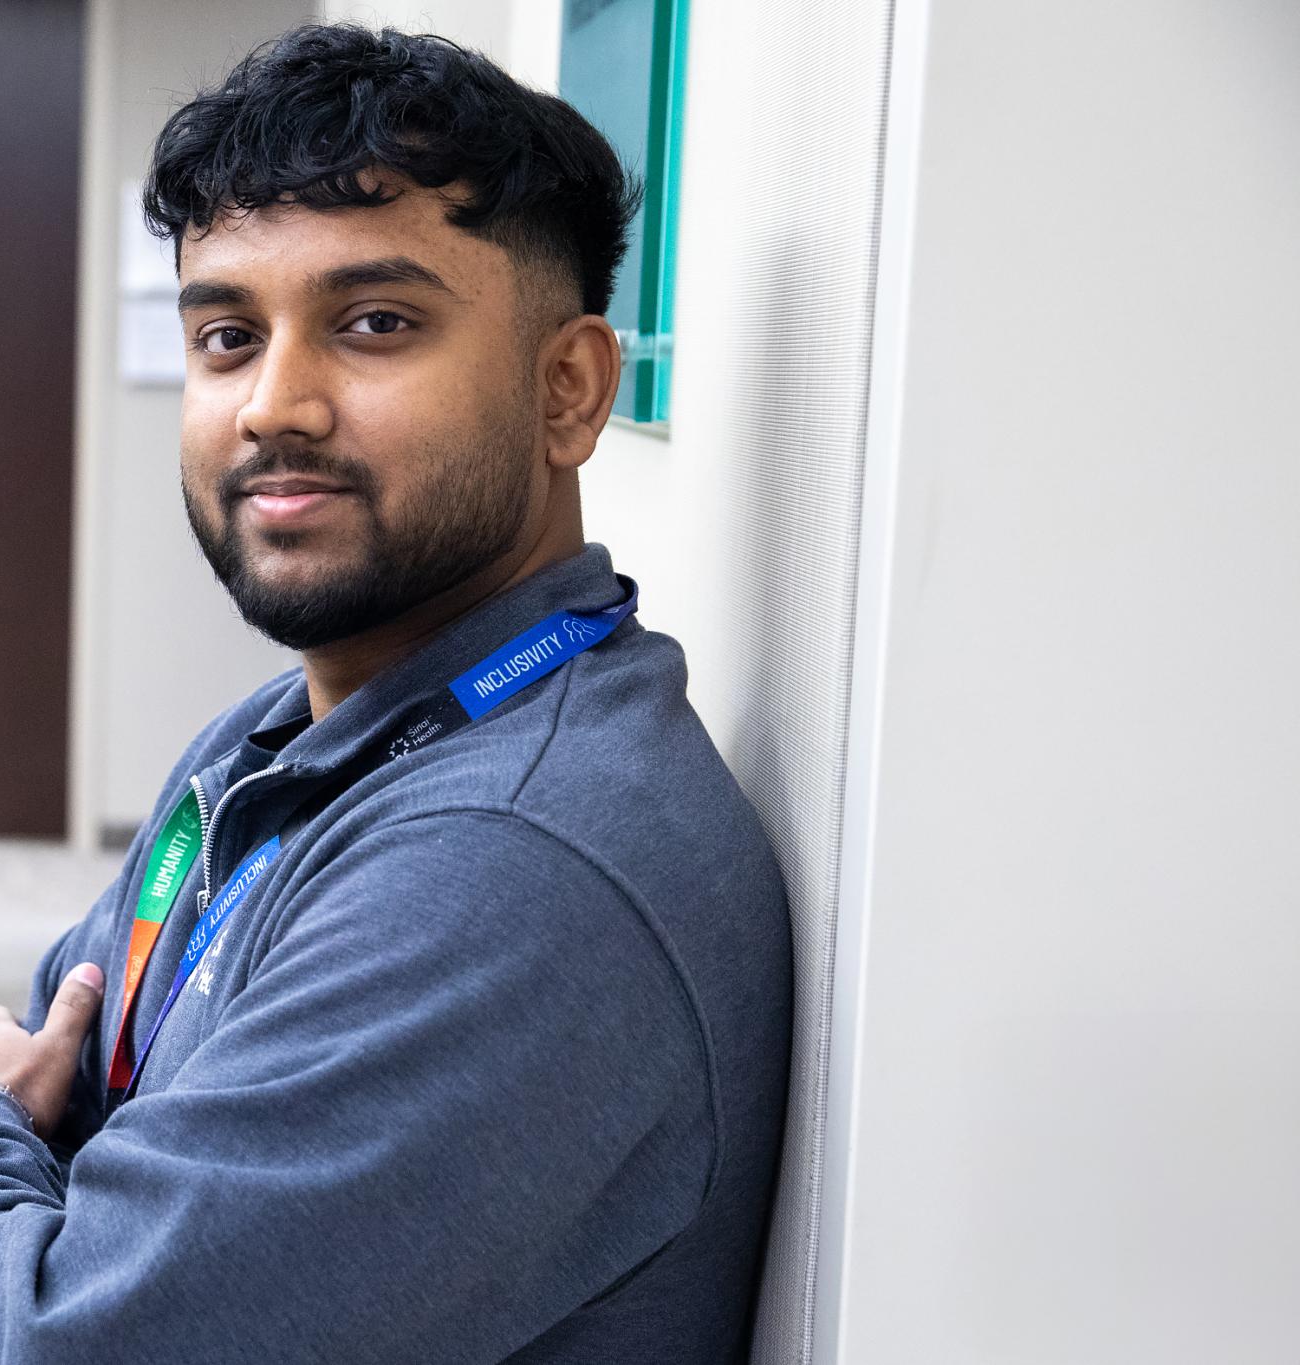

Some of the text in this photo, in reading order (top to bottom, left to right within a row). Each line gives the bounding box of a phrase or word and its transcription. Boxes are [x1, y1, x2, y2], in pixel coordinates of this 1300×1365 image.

[473, 632, 563, 698] INCLUSIVITY
[407, 716, 431, 738] Sinai
[412, 722, 443, 747] Health
[151, 829, 192, 898] HUMANITY
[210, 854, 268, 929] INCLUSIVITY
